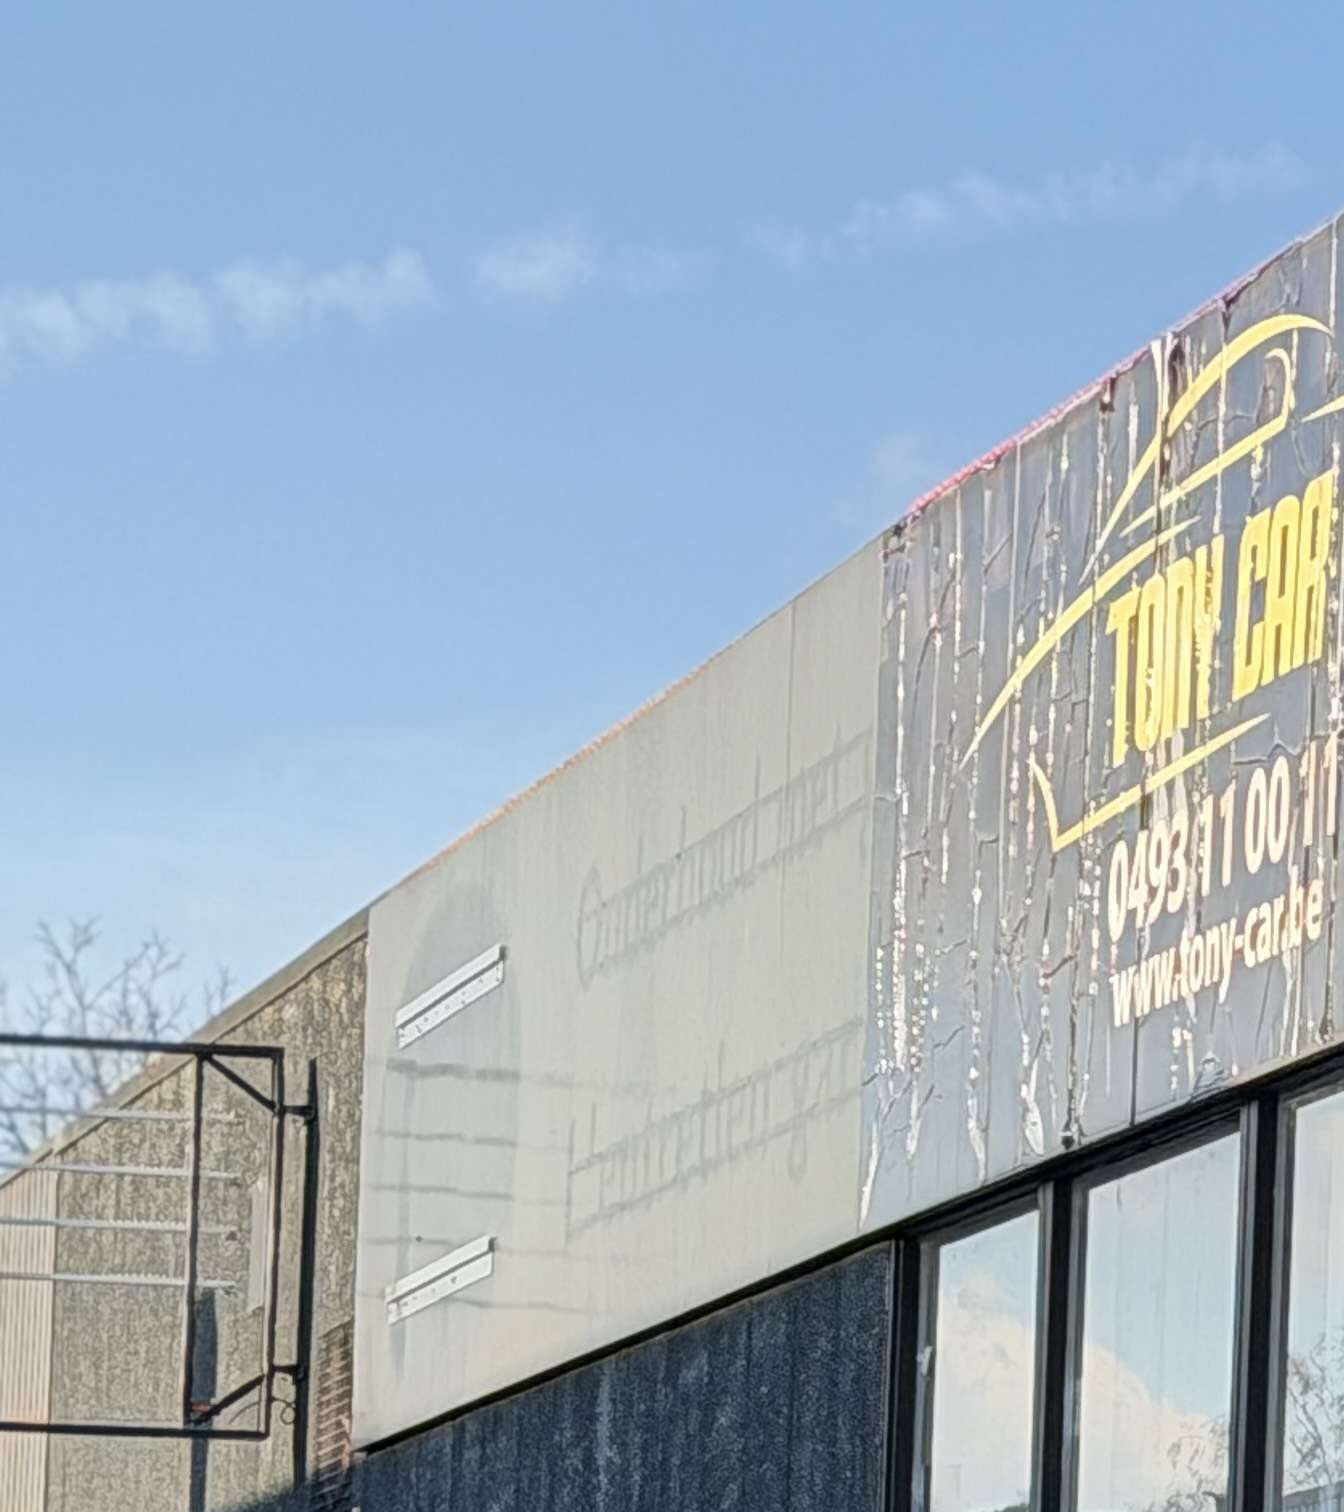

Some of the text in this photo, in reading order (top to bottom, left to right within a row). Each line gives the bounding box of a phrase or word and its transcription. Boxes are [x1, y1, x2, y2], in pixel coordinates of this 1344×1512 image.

[1105, 468, 1336, 768] TONY CAR
[1107, 731, 1338, 943] 0493 11 00 11
[1109, 863, 1325, 1028] www.tony-car.be
